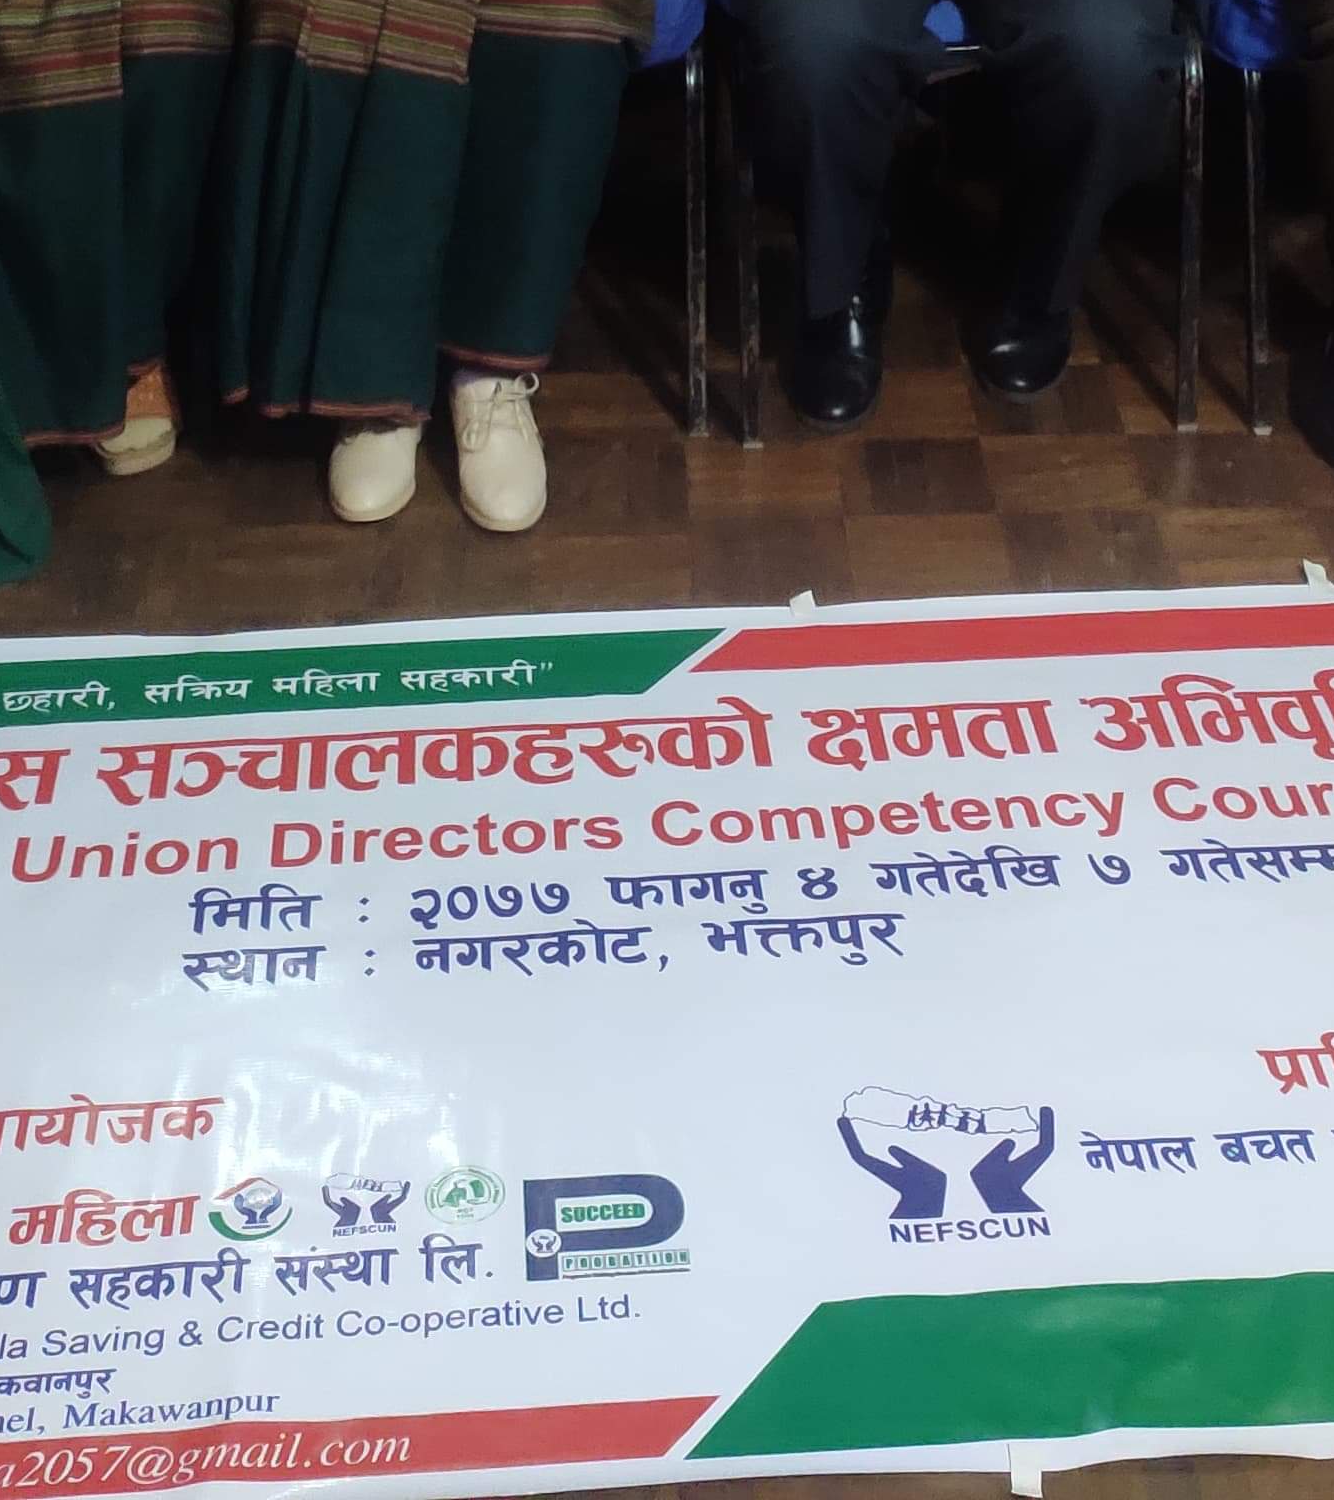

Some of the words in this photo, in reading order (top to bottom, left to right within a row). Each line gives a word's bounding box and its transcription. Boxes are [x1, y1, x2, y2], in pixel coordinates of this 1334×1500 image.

[144, 674, 253, 704] सक्रिय
[272, 668, 381, 697] महिला
[803, 699, 1056, 770] क्षमता
[13, 835, 239, 882] Union
[271, 815, 621, 867] Directors
[651, 792, 1124, 847] Competency
[187, 883, 324, 935] मिति
[409, 882, 570, 931] २०७७
[796, 867, 839, 901] ४
[868, 844, 1061, 898] गतेदेखि
[1087, 853, 1131, 885] ७
[181, 945, 327, 992] स्थान
[412, 918, 670, 978] नगरकोट,
[700, 907, 906, 966] भक्तपुर
[1078, 1130, 1198, 1174] नेपाल
[1212, 1129, 1316, 1166] बचत
[9, 1187, 200, 1246] महिला
[332, 1224, 397, 1238] NEFSCUN
[889, 1216, 1052, 1244] NEFSCUN
[68, 1247, 252, 1311] सहकारी
[275, 1246, 400, 1297] संस्था
[418, 1233, 494, 1283] लि.
[41, 1328, 165, 1357] Saving
[178, 1320, 203, 1347] &
[217, 1314, 325, 1343] Credit
[336, 1301, 564, 1339] Co-operative
[577, 1293, 641, 1322] Ltd.
[62, 1392, 280, 1429] Makawanpur
